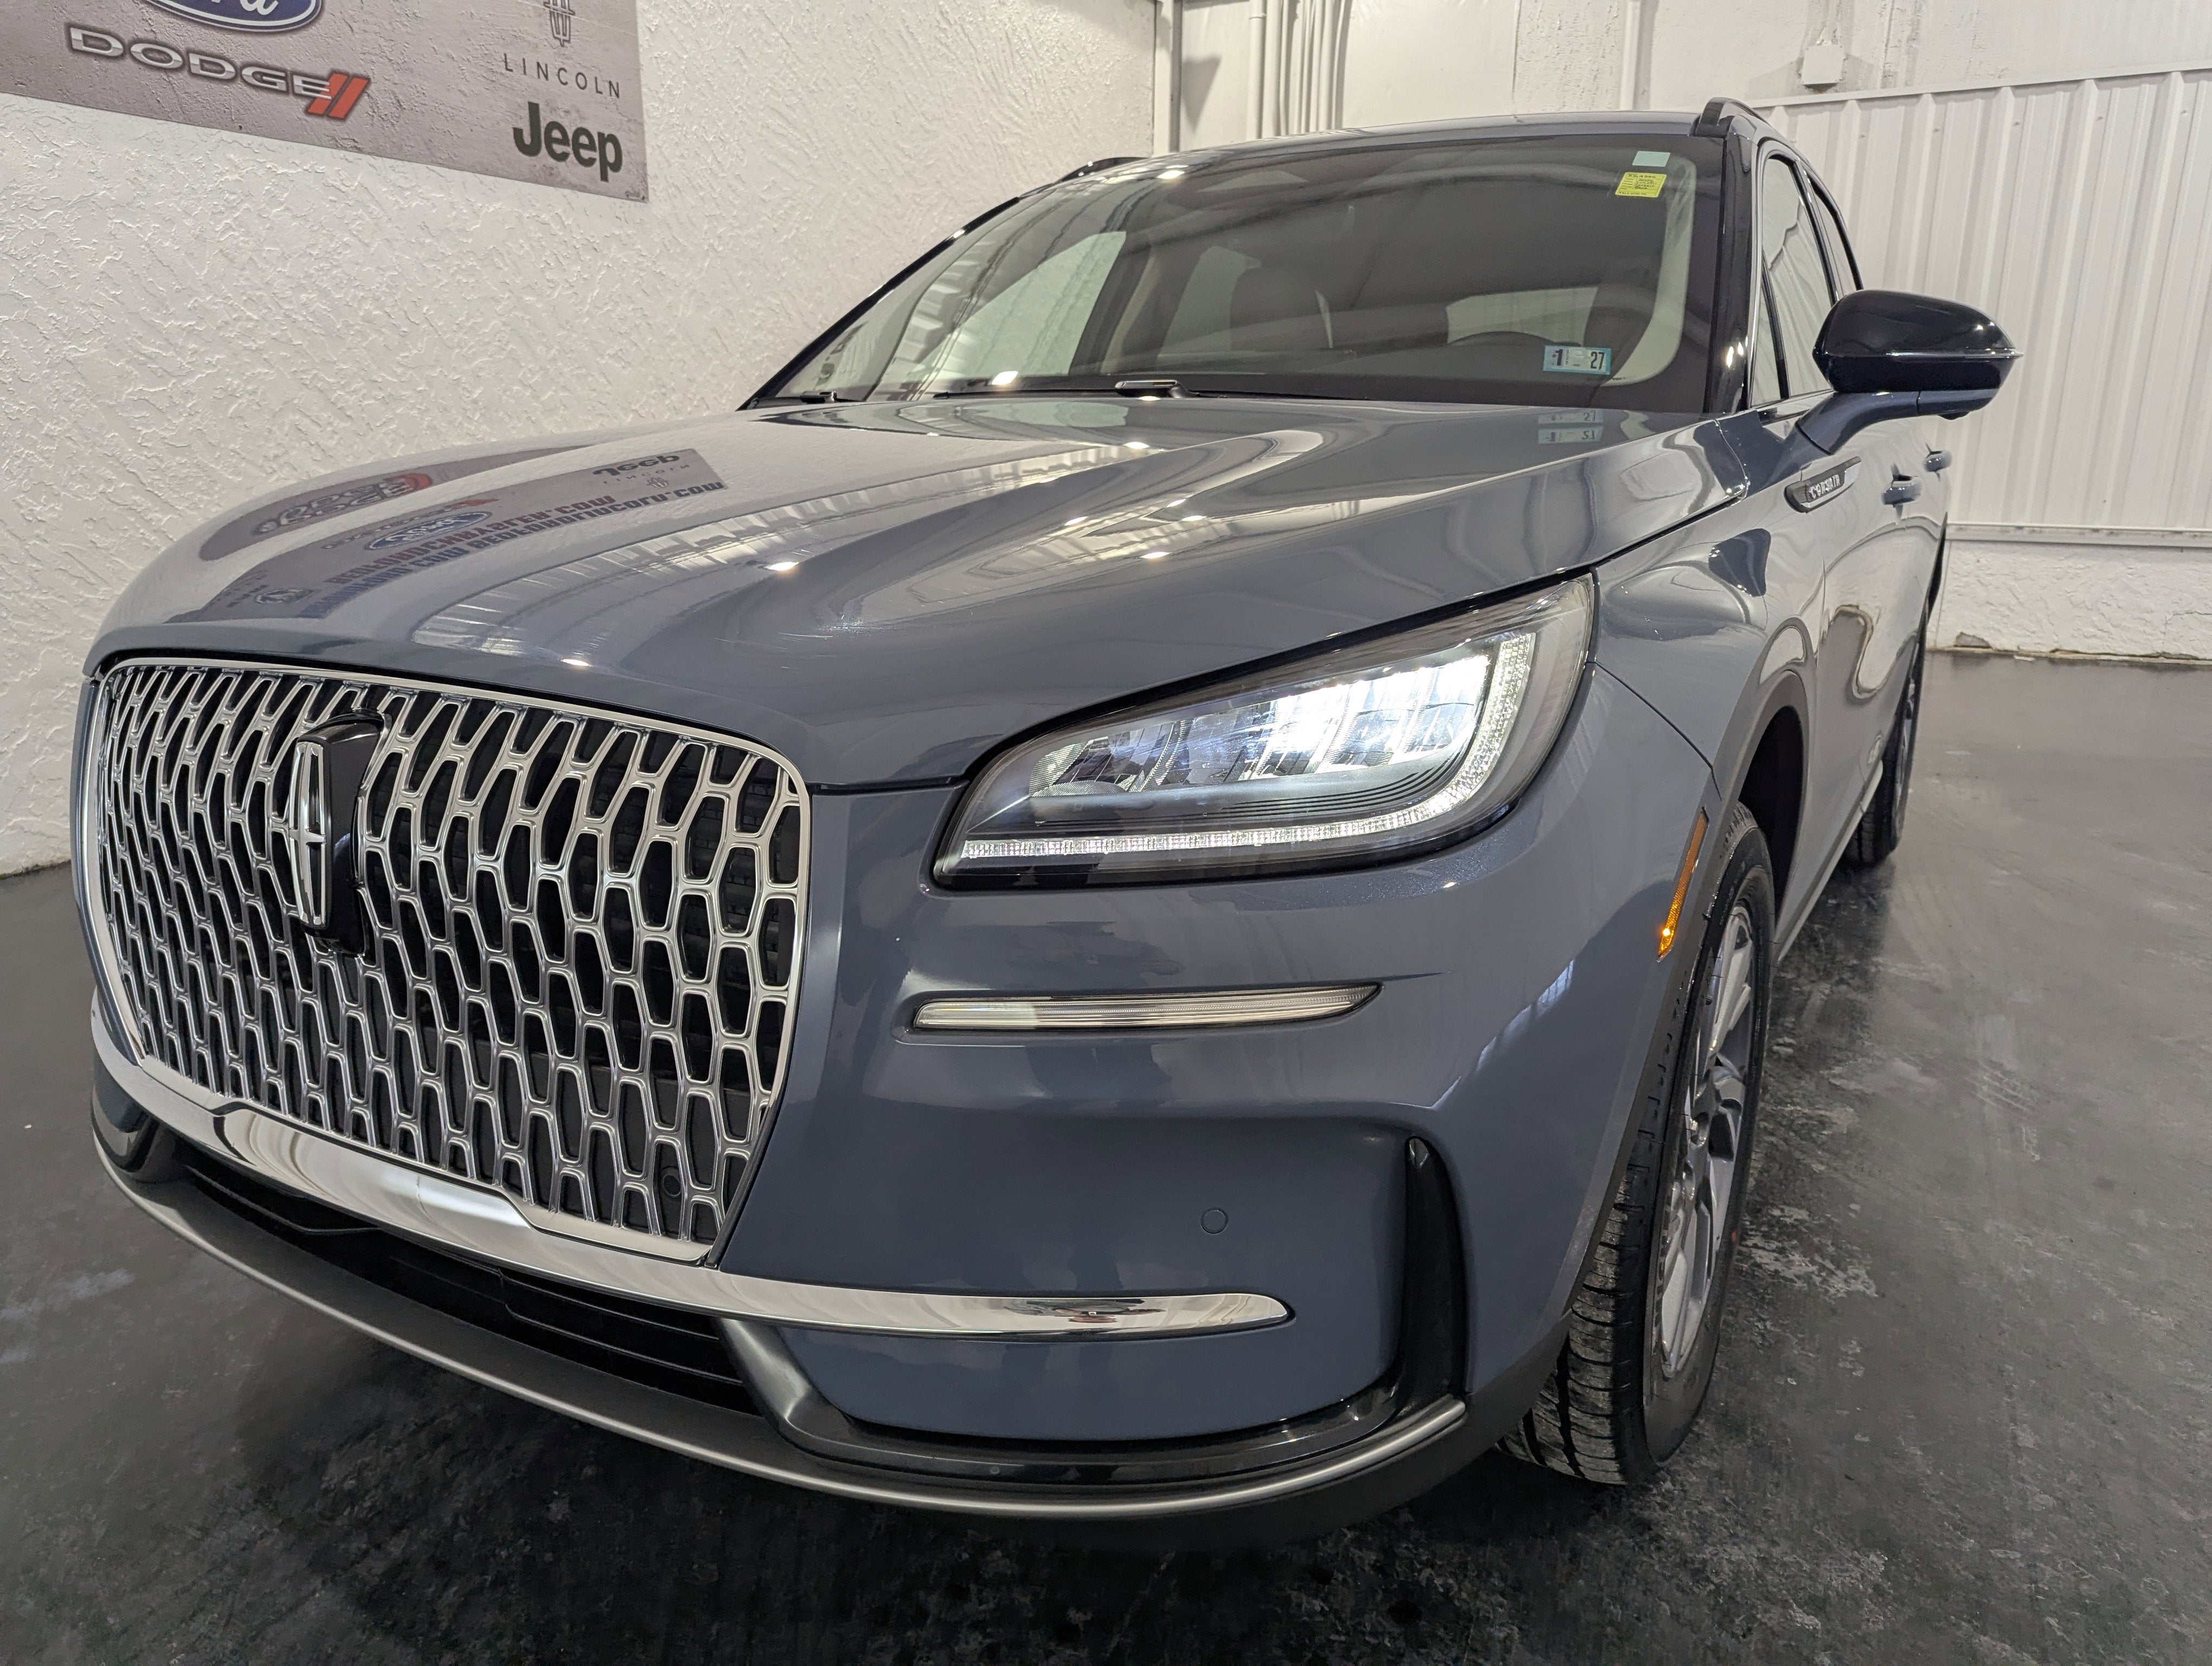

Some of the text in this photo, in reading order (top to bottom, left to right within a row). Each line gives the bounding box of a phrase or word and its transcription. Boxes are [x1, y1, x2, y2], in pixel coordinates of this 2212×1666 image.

[69, 27, 332, 100] DODGE
[503, 53, 620, 99] LINCOLN
[512, 101, 623, 183] Jeep
[1590, 351, 1605, 370] 27
[1810, 474, 1841, 499] CORSAIR
